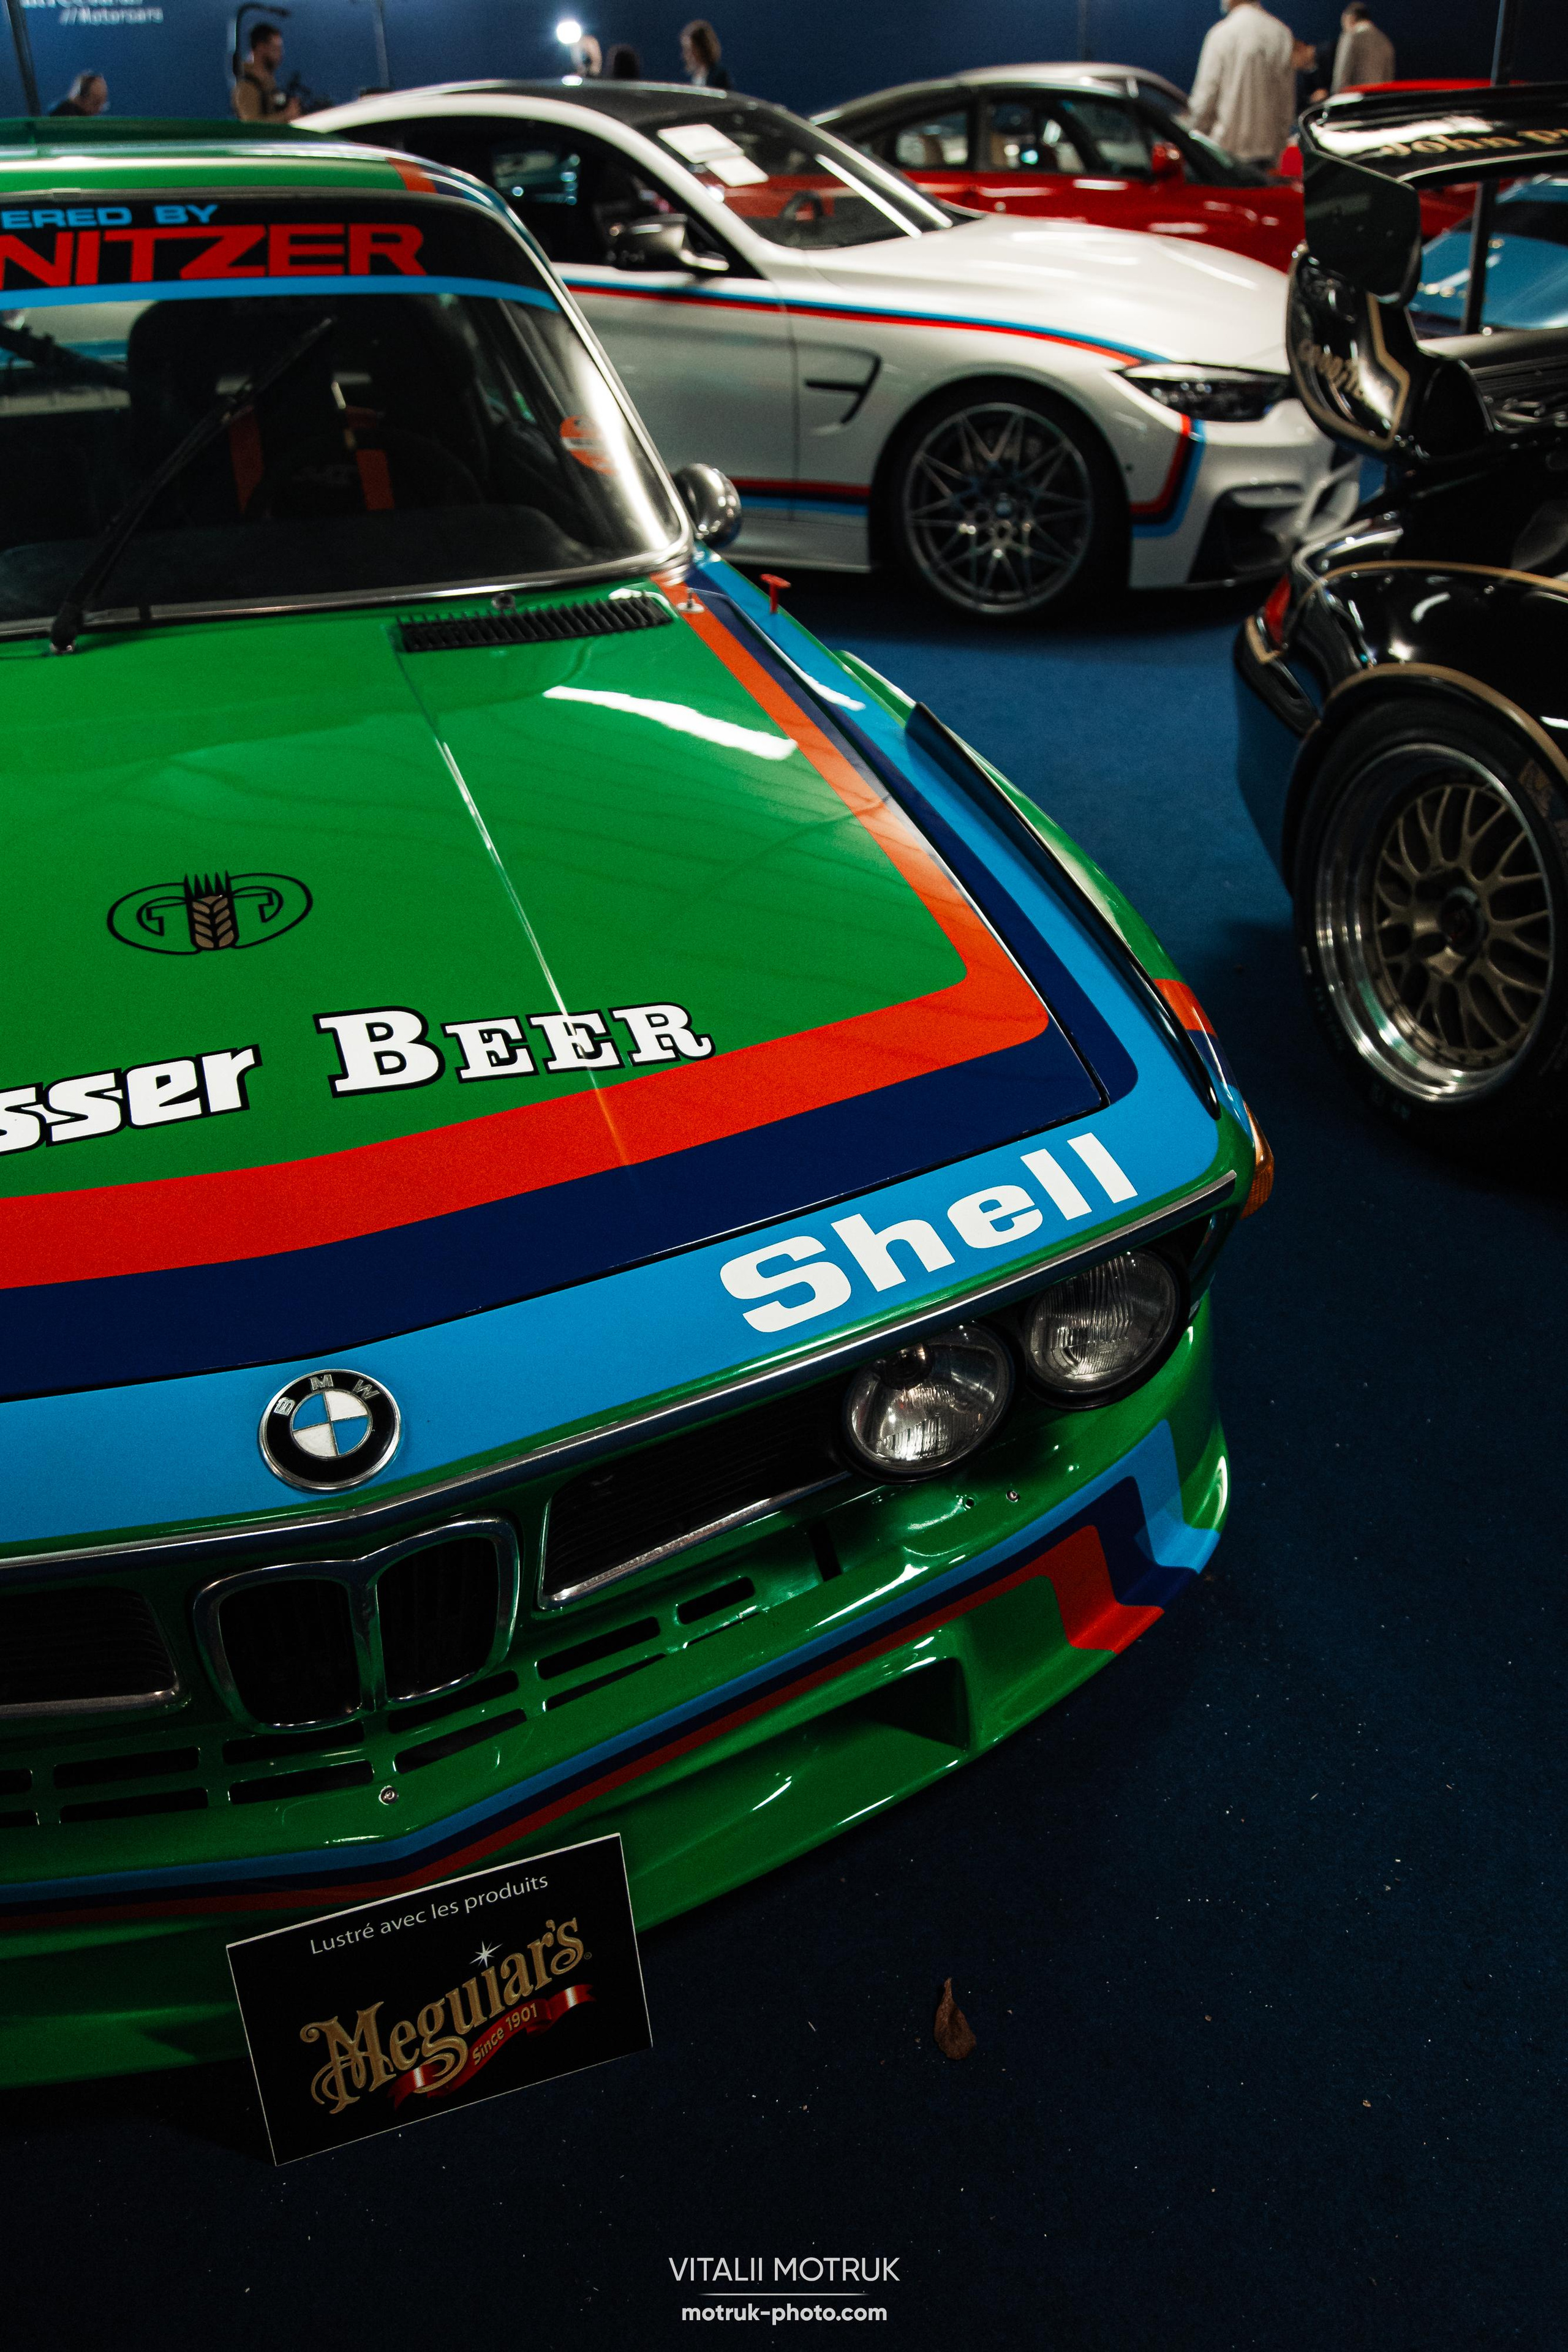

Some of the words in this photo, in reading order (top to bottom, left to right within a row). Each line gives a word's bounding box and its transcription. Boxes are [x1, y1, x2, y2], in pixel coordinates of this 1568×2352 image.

[1, 206, 133, 229] ERED
[154, 204, 219, 225] BY
[0, 224, 428, 290] NITZER
[0, 1044, 263, 1156] sser
[313, 1001, 716, 1098] BEER
[720, 1132, 1138, 1333] Shell
[273, 1373, 380, 1416] BMW
[309, 1922, 375, 1955] Lustré
[380, 1907, 428, 1933] avec
[431, 1899, 460, 1920] les
[464, 1873, 549, 1913] produits
[300, 1917, 586, 2114] Meguiar's
[472, 2027, 504, 2067] Since
[505, 2002, 538, 2034] 1901
